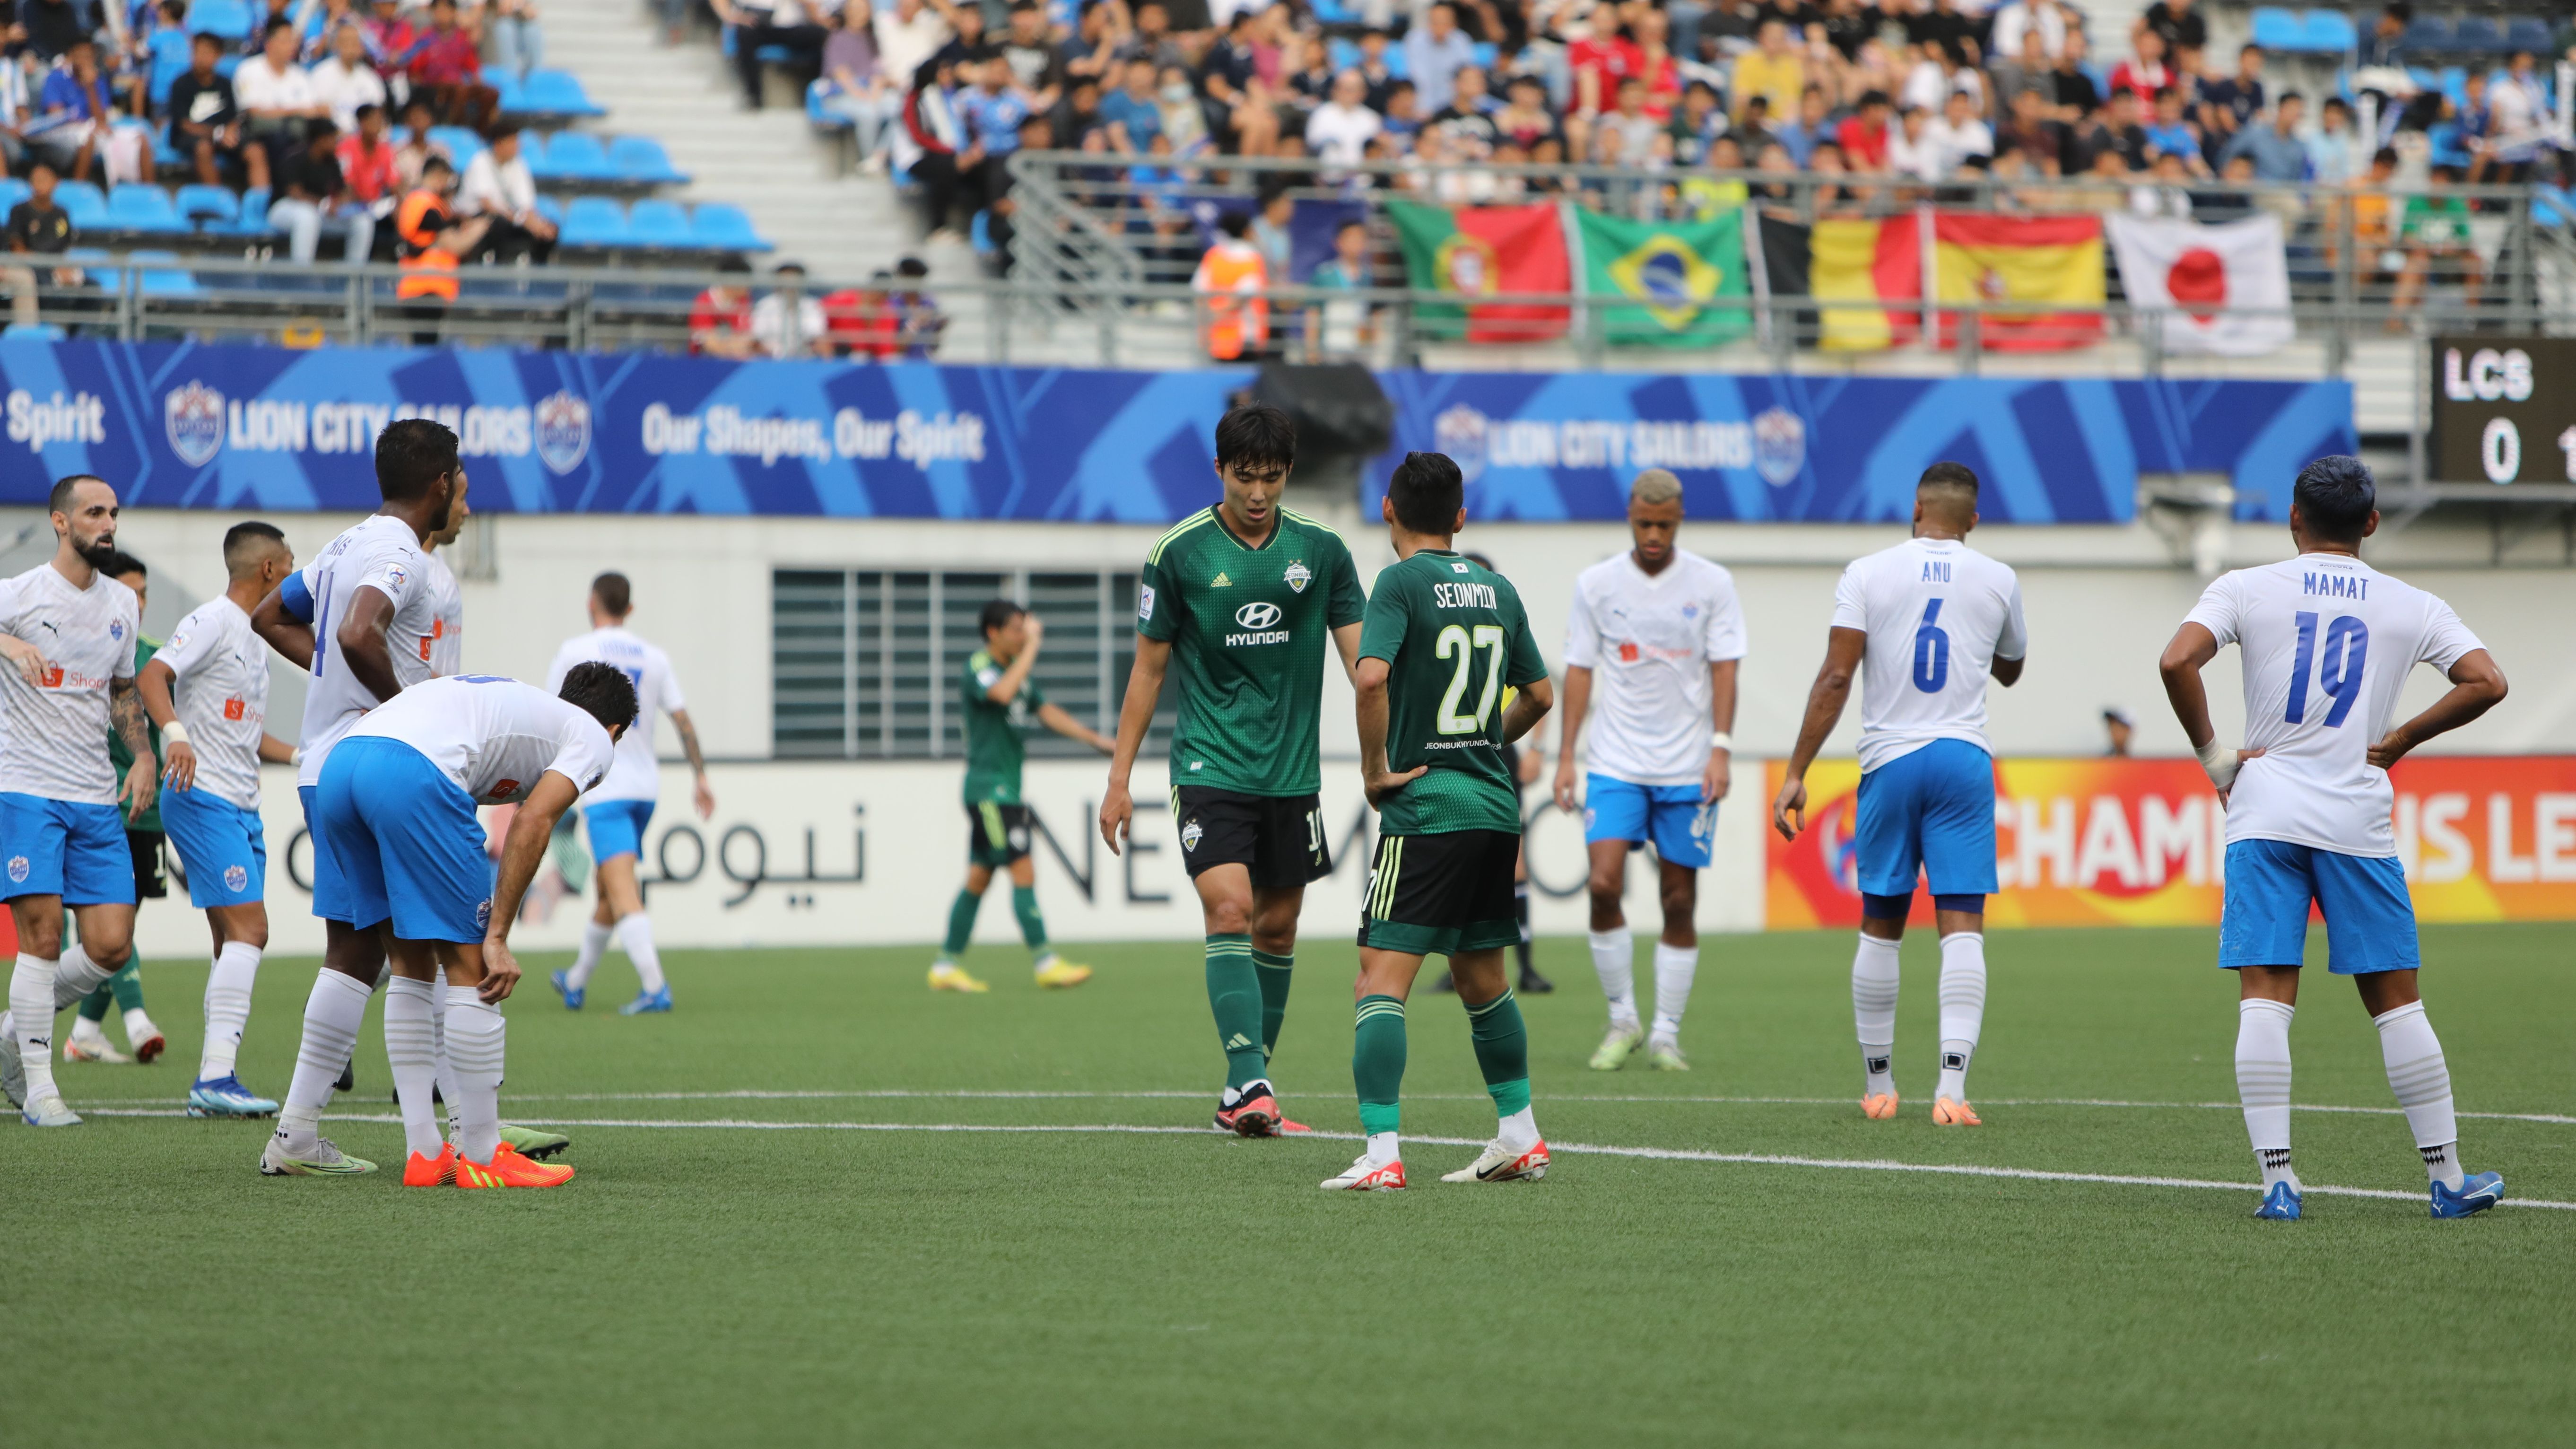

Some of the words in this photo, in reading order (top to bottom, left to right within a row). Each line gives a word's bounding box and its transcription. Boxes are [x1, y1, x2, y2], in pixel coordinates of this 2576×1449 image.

[2444, 348, 2534, 402] LCS
[7, 389, 106, 453] Spirit
[228, 399, 307, 453] LION
[312, 402, 391, 454] CITY
[394, 402, 532, 458] LORS
[642, 403, 703, 455] Our
[705, 404, 831, 466] Shapes,
[834, 408, 894, 459] Our
[896, 409, 985, 469] Spirit
[1488, 420, 1559, 469] LION
[1562, 420, 1625, 469] CITY
[1629, 421, 1753, 471] SAILORS
[2482, 417, 2521, 485] 0
[1434, 582, 1497, 610] SEONMIN
[1922, 561, 1951, 583] ANU
[2304, 572, 2369, 602] MAMAT
[1226, 630, 1289, 646] HYUNDAI
[1913, 598, 1950, 694] 6
[1436, 624, 1504, 735] 27
[2284, 611, 2369, 729] 19
